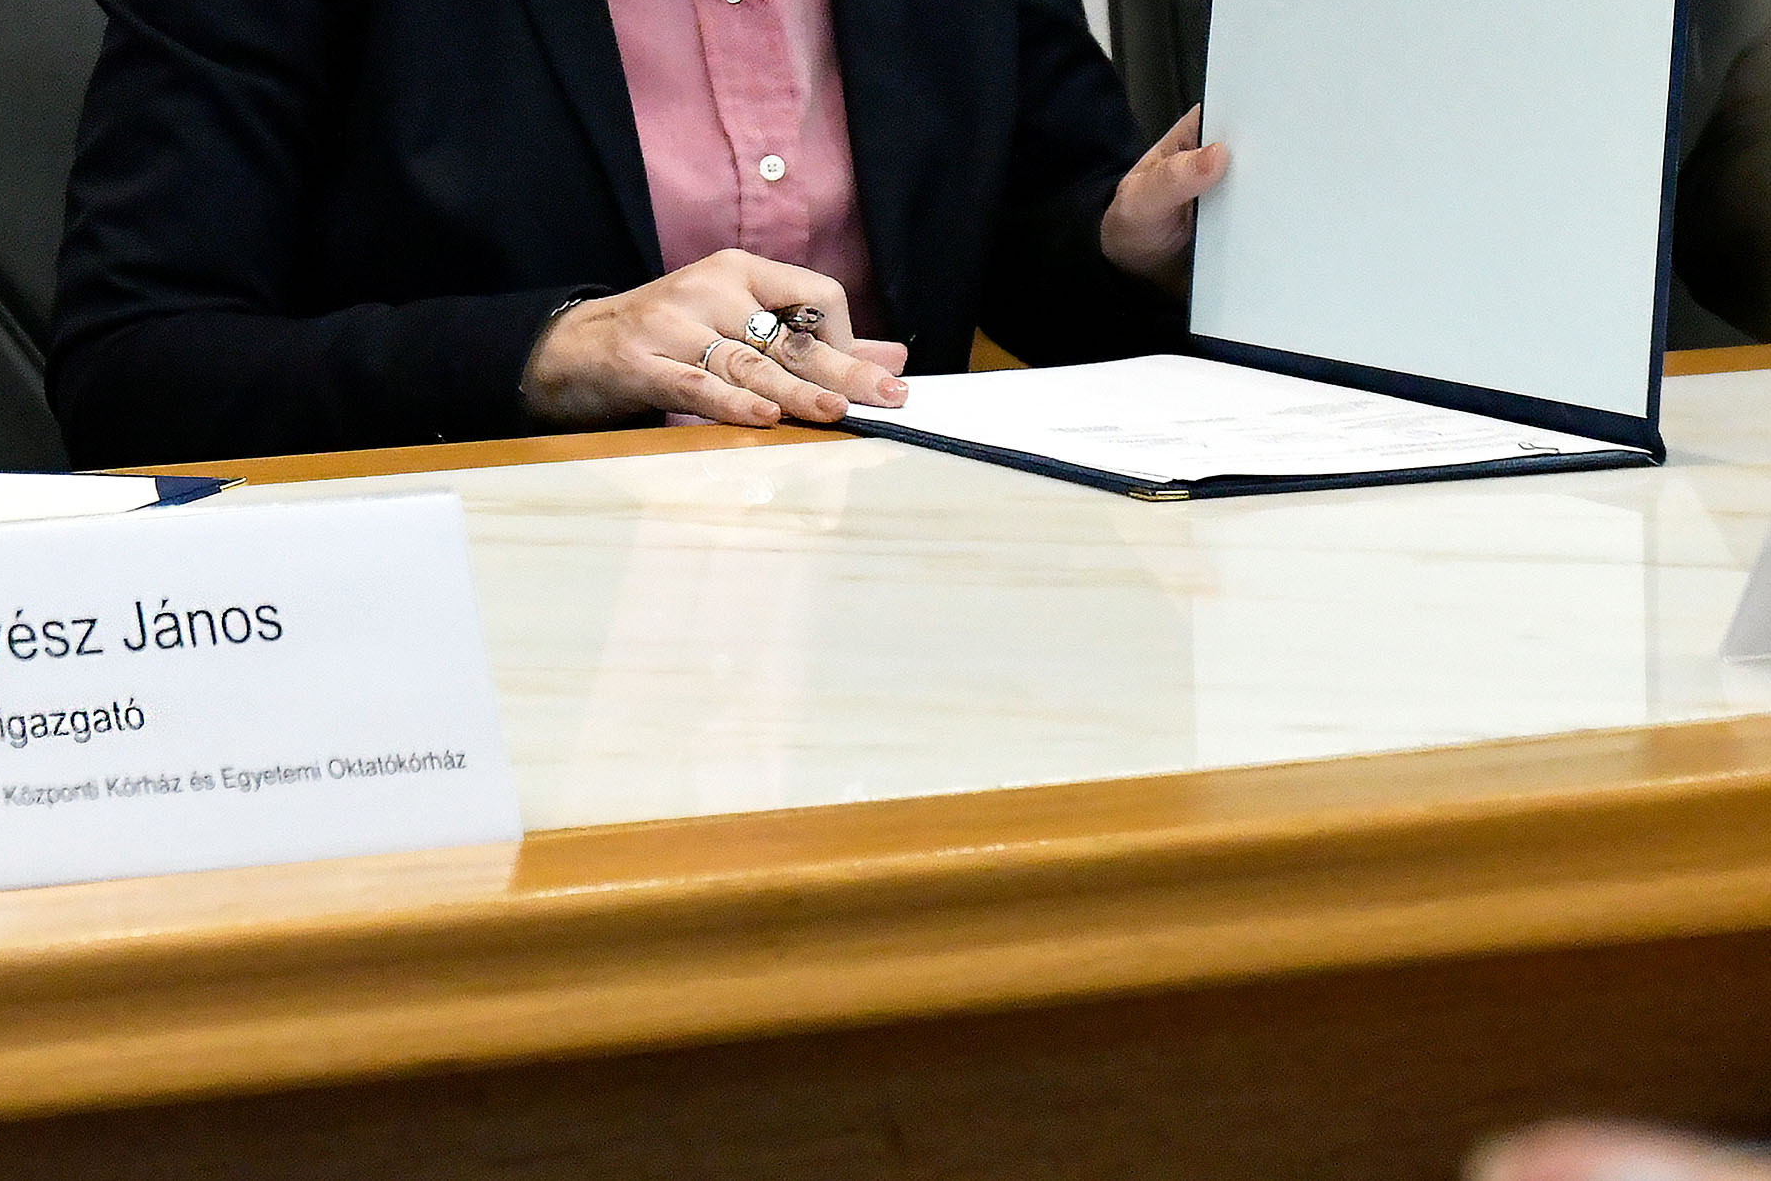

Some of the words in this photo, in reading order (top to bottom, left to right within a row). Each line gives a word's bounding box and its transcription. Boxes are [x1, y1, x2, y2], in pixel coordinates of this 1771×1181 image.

[123, 599, 282, 652] János
[104, 772, 182, 799] Kórház
[189, 768, 216, 792] és
[220, 761, 322, 793] Egyetemi
[328, 748, 468, 781] Oktatókórház
